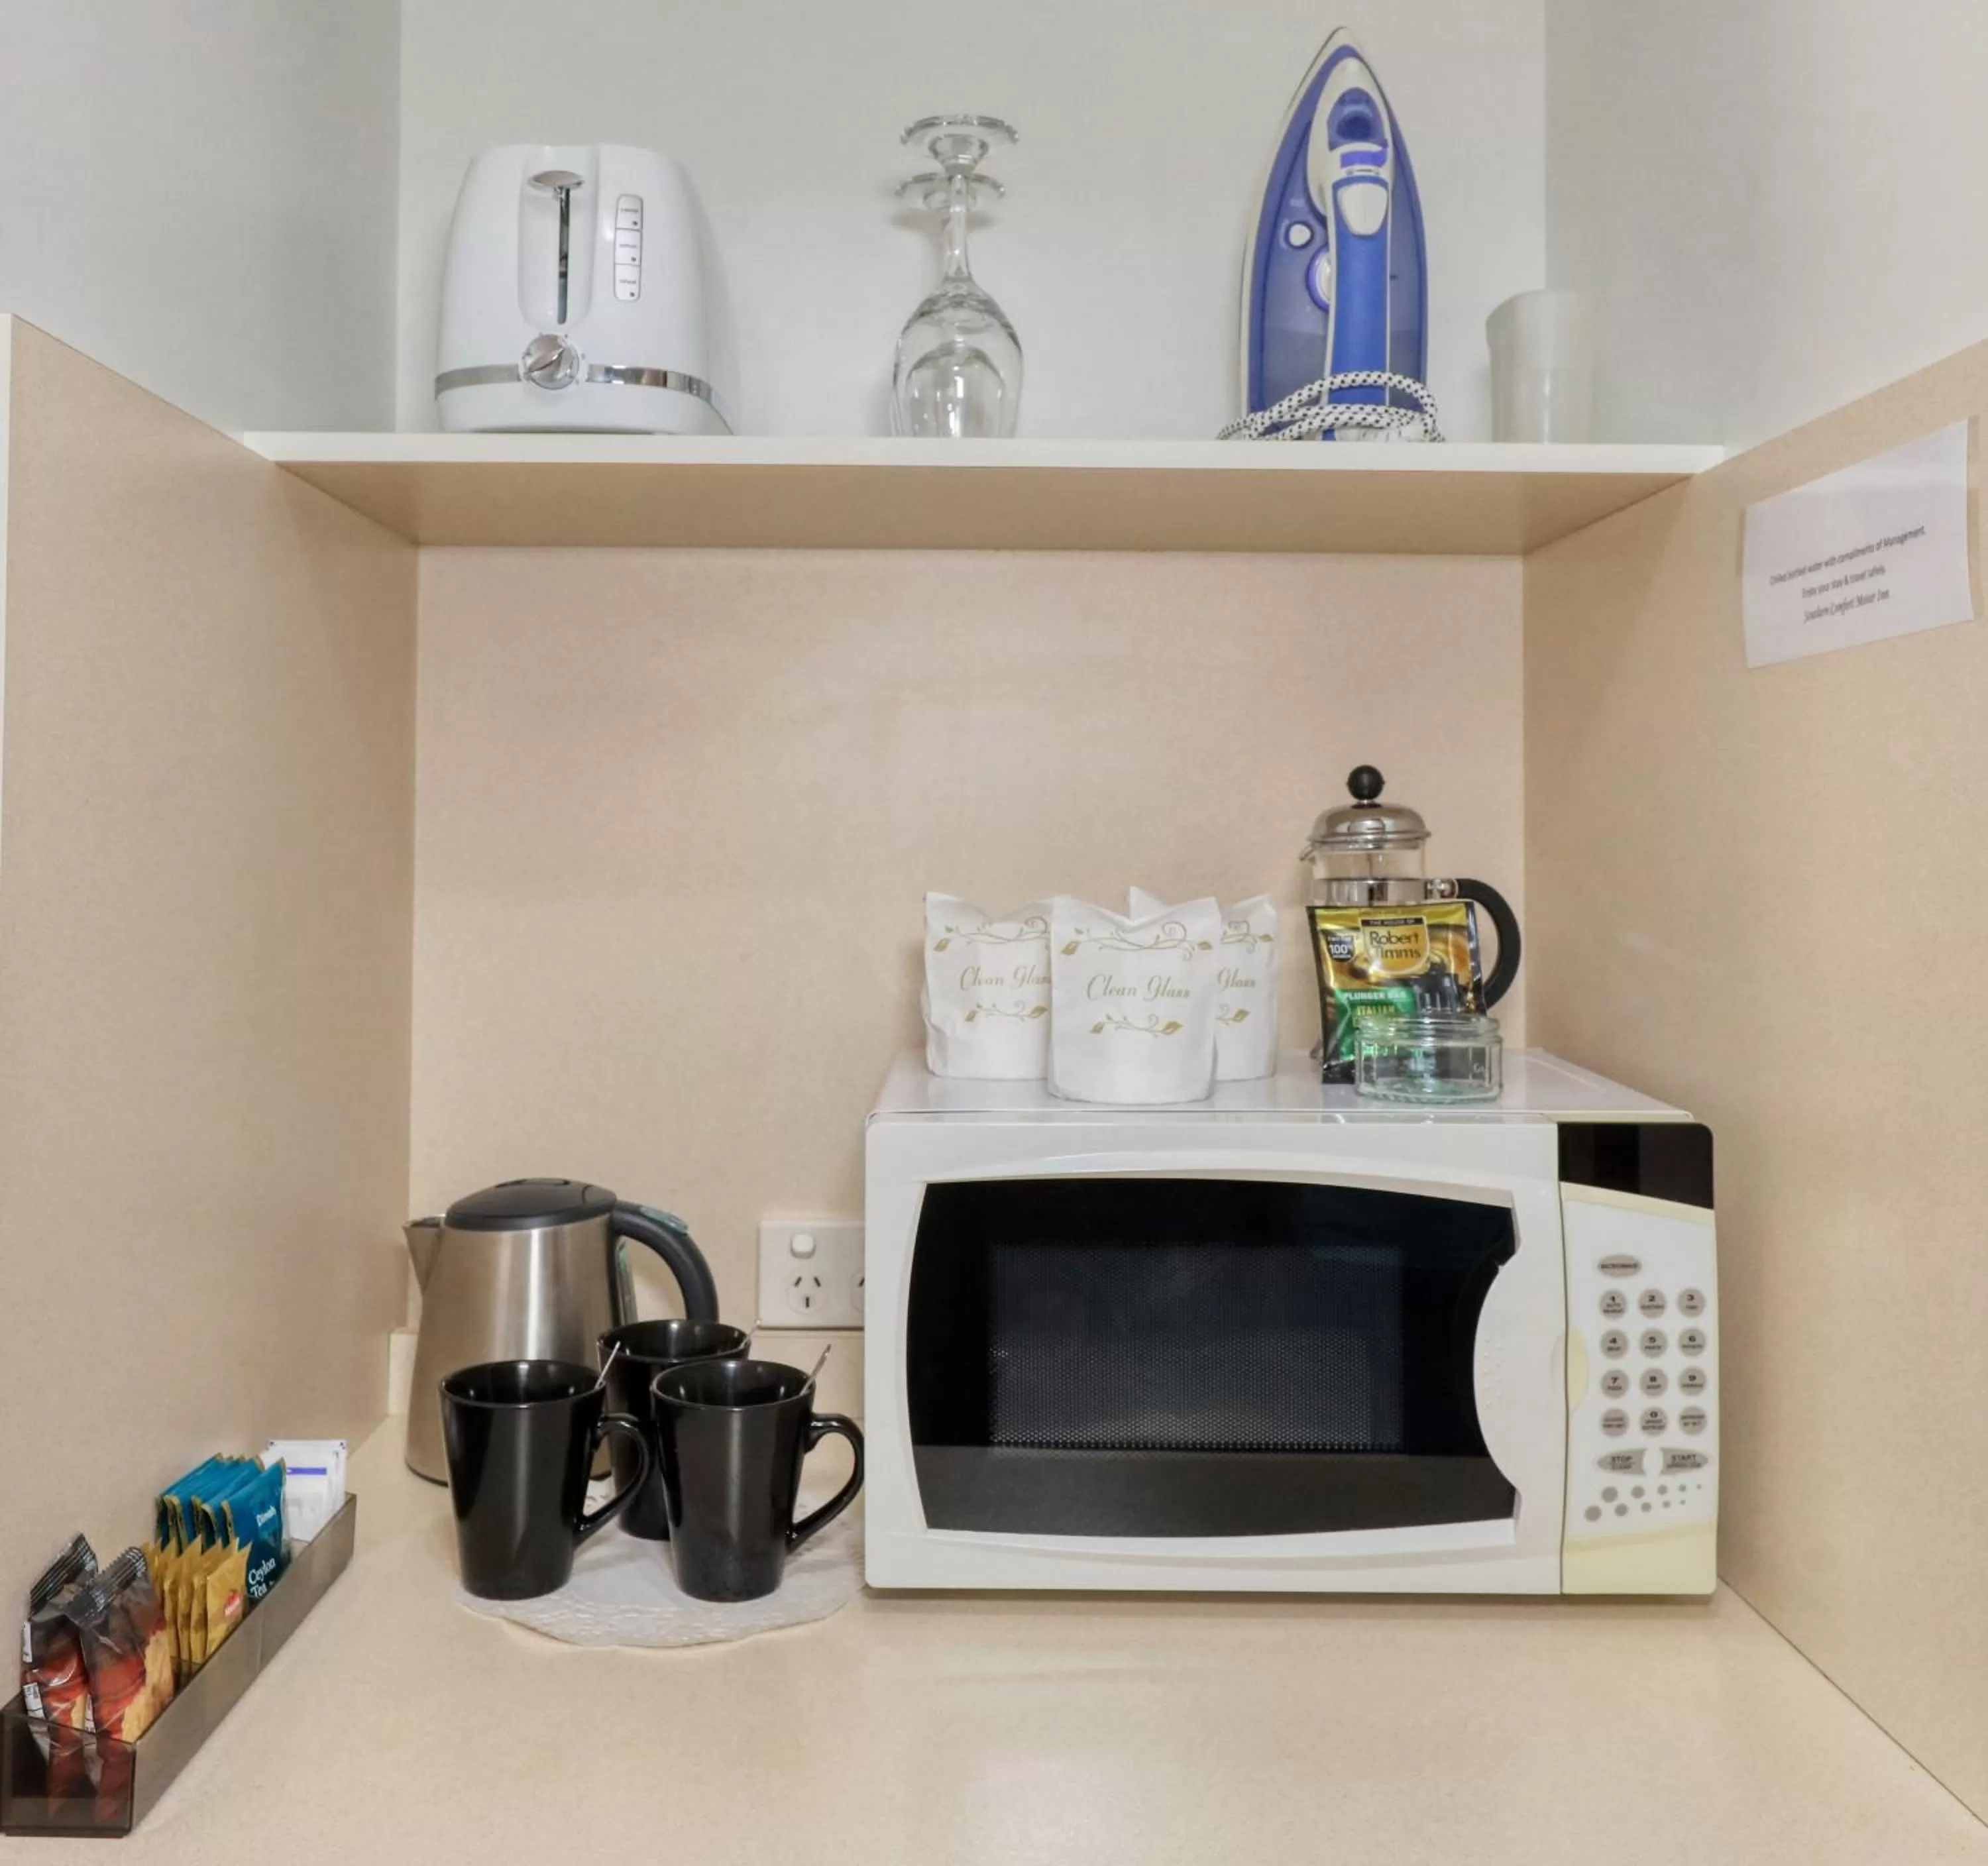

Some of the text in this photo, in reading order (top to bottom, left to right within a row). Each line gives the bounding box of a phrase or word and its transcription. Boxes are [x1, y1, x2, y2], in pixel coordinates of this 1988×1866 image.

[1369, 930, 1419, 946] Robert
[960, 965, 1005, 992] Clean
[1086, 973, 1191, 1002] Clean Glass
[1686, 1293, 1695, 1302] 3
[1688, 1335, 1696, 1343] 6
[1611, 1376, 1620, 1384] 7
[1649, 1375, 1657, 1384] 8
[1688, 1374, 1697, 1382] 9
[1611, 1454, 1633, 1463] STOP
[248, 1558, 276, 1585] Ceylon
